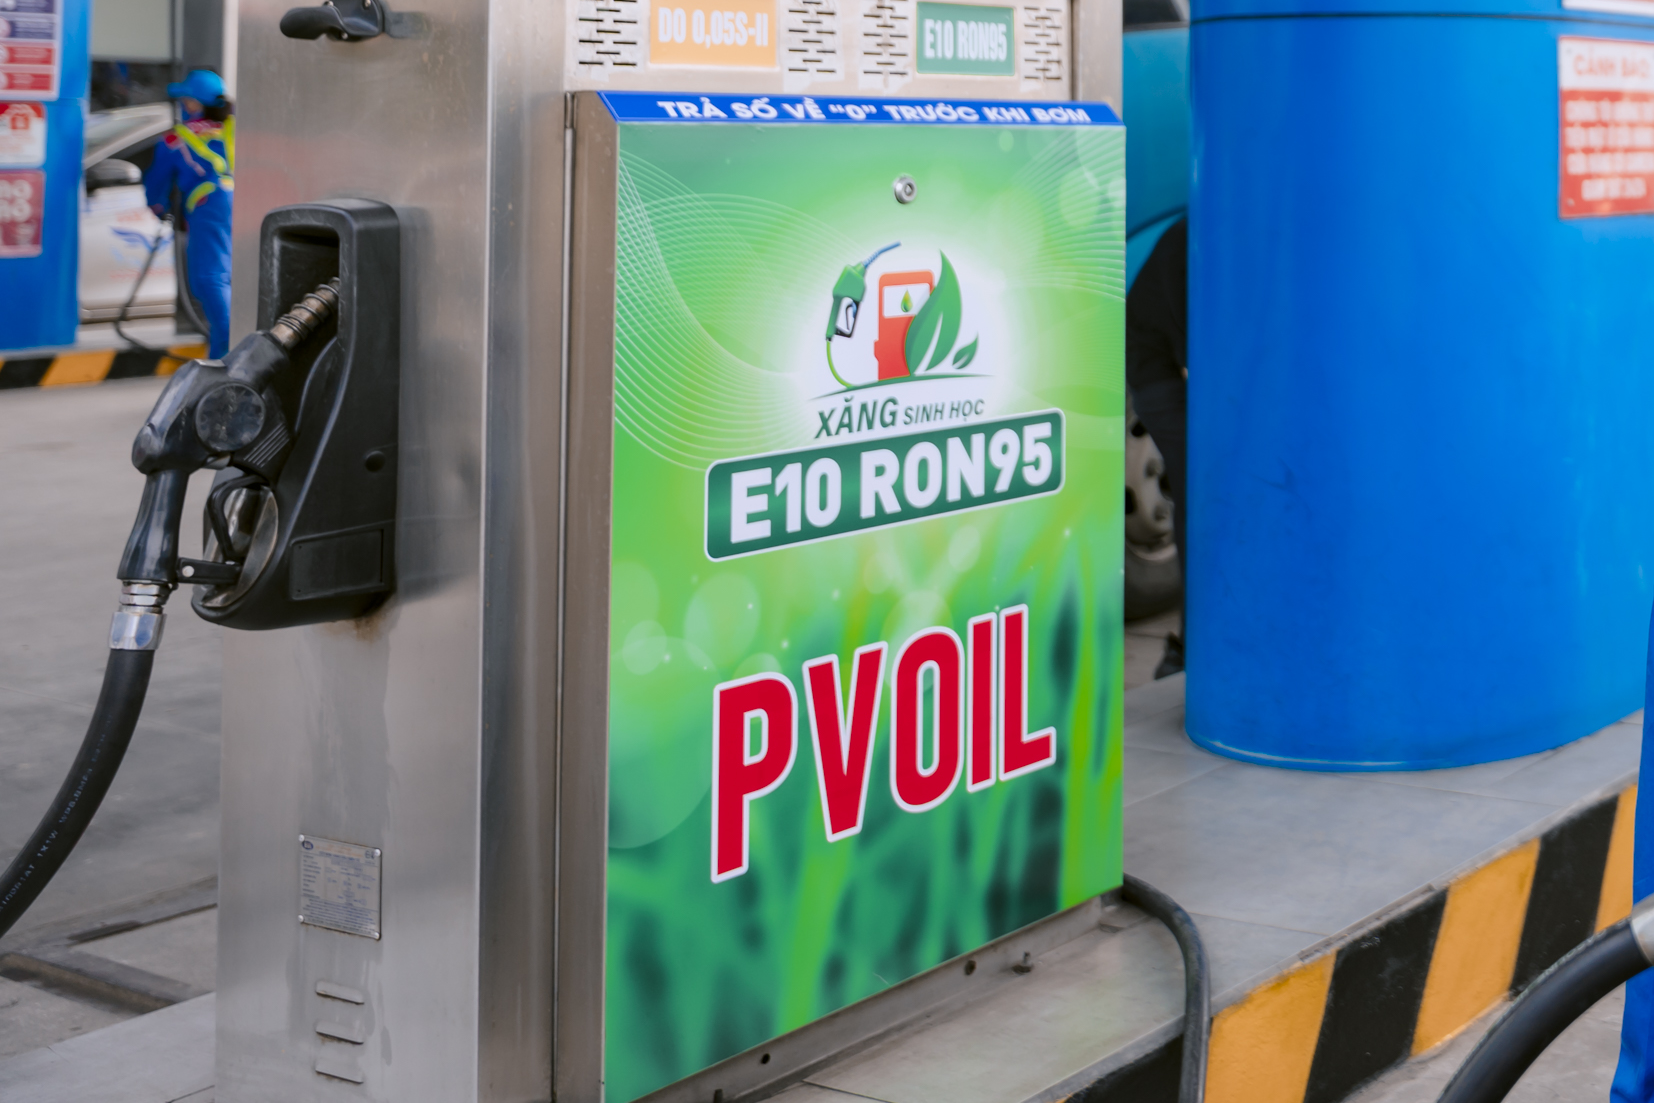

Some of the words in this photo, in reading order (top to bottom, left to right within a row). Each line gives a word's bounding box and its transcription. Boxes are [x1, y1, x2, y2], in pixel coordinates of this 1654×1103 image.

[658, 7, 687, 43] DO
[692, 9, 769, 50] 0,05S-II
[924, 18, 954, 60] E10
[957, 21, 1008, 61] RON95
[657, 97, 728, 118] TRẢ
[730, 97, 778, 119] SỐ
[781, 96, 826, 119] VỀ
[882, 102, 980, 122] TRƯỚC
[981, 106, 1031, 123] KHI
[1031, 106, 1092, 124] BƠM
[815, 396, 899, 440] XĂNG
[903, 403, 945, 427] SINH
[949, 397, 985, 423] HỌC
[730, 457, 843, 545] E10
[859, 421, 1053, 521] RON95
[710, 603, 1057, 883] PVOIL
